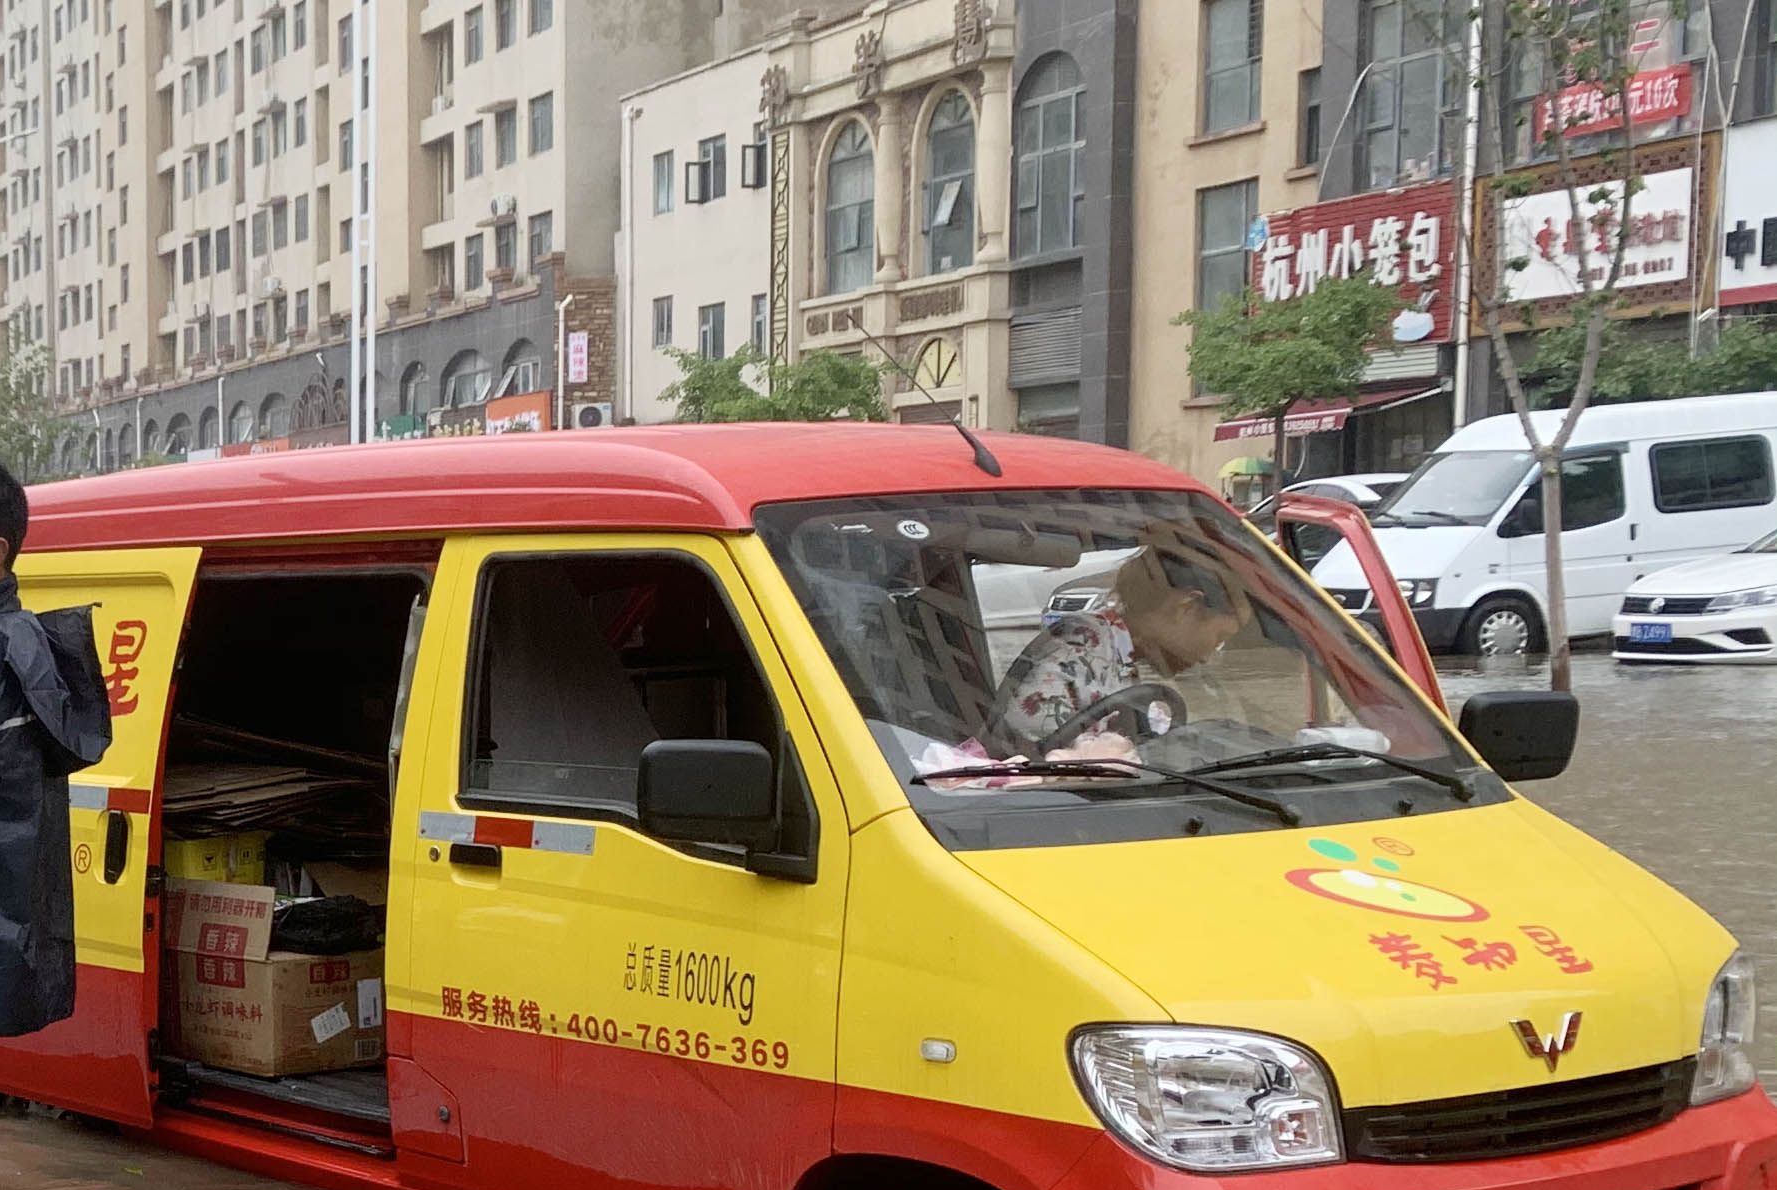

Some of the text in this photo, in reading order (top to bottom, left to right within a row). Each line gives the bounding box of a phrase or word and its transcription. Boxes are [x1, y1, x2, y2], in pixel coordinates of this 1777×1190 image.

[1262, 211, 1442, 302] 杭州小笼包
